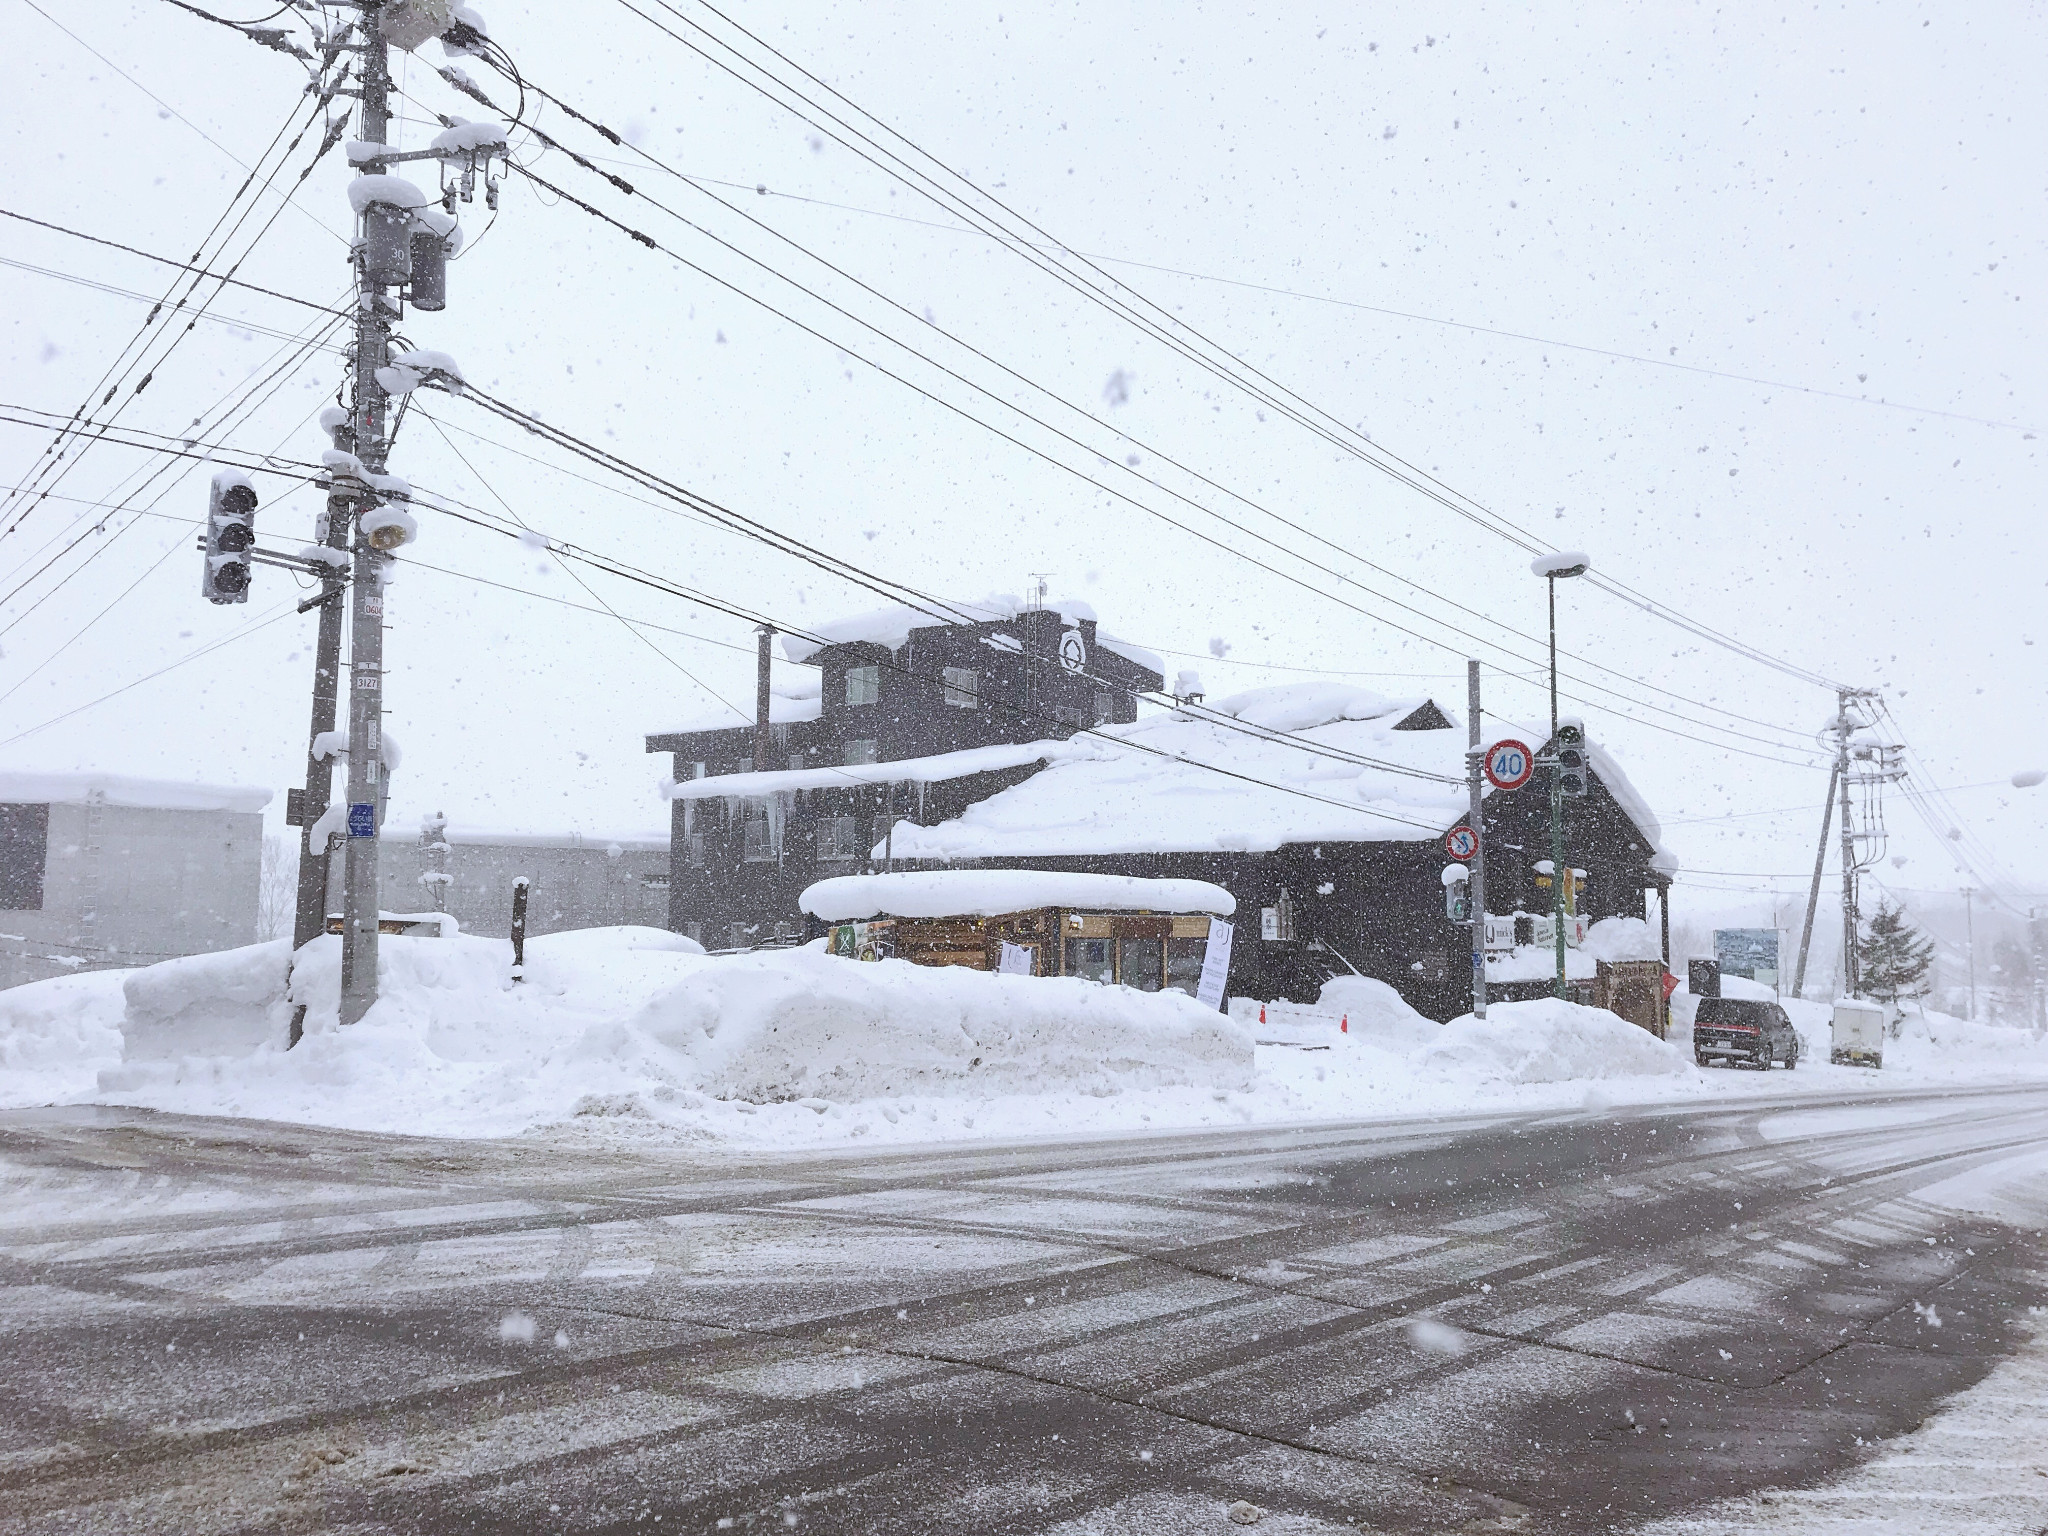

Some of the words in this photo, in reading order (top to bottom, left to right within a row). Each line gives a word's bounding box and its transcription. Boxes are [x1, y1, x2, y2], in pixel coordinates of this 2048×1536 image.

[391, 247, 404, 260] 30
[359, 678, 376, 688] 3127
[1496, 753, 1522, 775] 40
